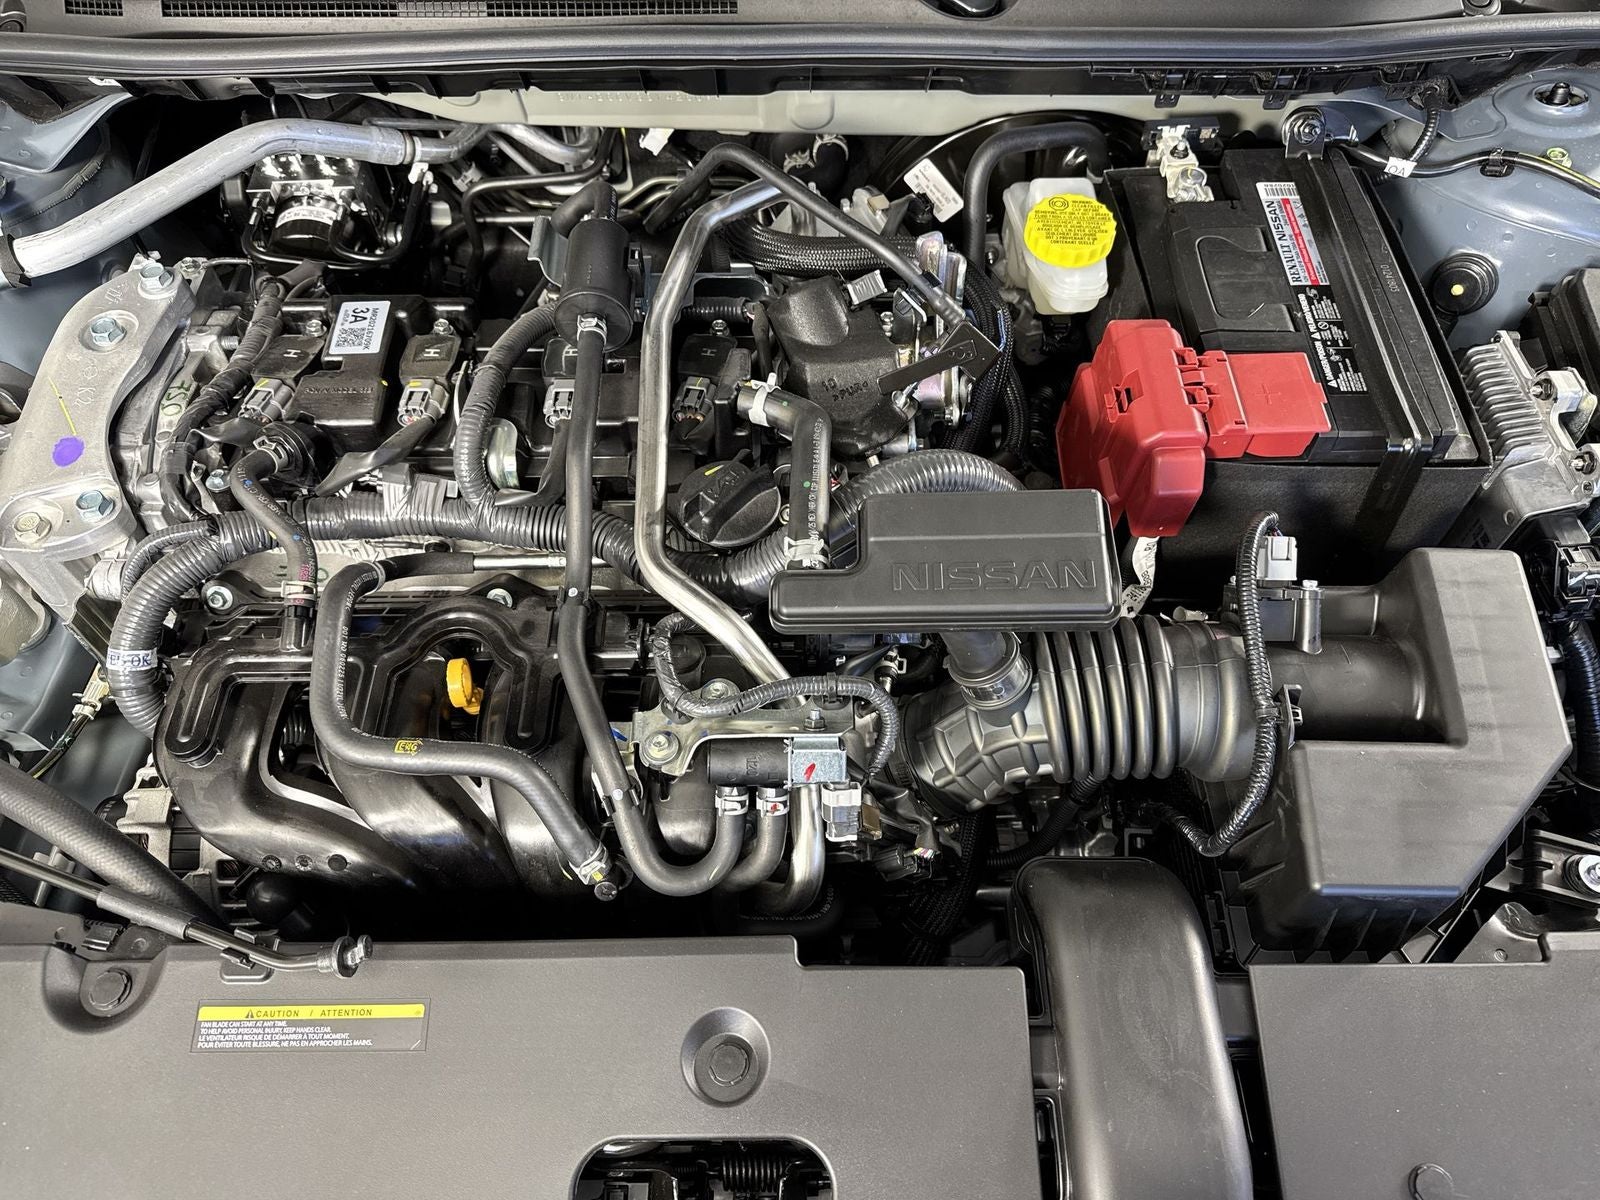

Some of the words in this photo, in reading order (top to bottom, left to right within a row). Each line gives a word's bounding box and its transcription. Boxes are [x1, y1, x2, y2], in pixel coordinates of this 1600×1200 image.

[1265, 200, 1288, 242] NISSAN
[1281, 242, 1302, 282] RENAULT
[349, 307, 370, 324] 3A
[424, 348, 440, 357] H
[892, 560, 1097, 592] NISSAN
[256, 1010, 300, 1018] CAUTION
[320, 1008, 372, 1017] ATTENTION
